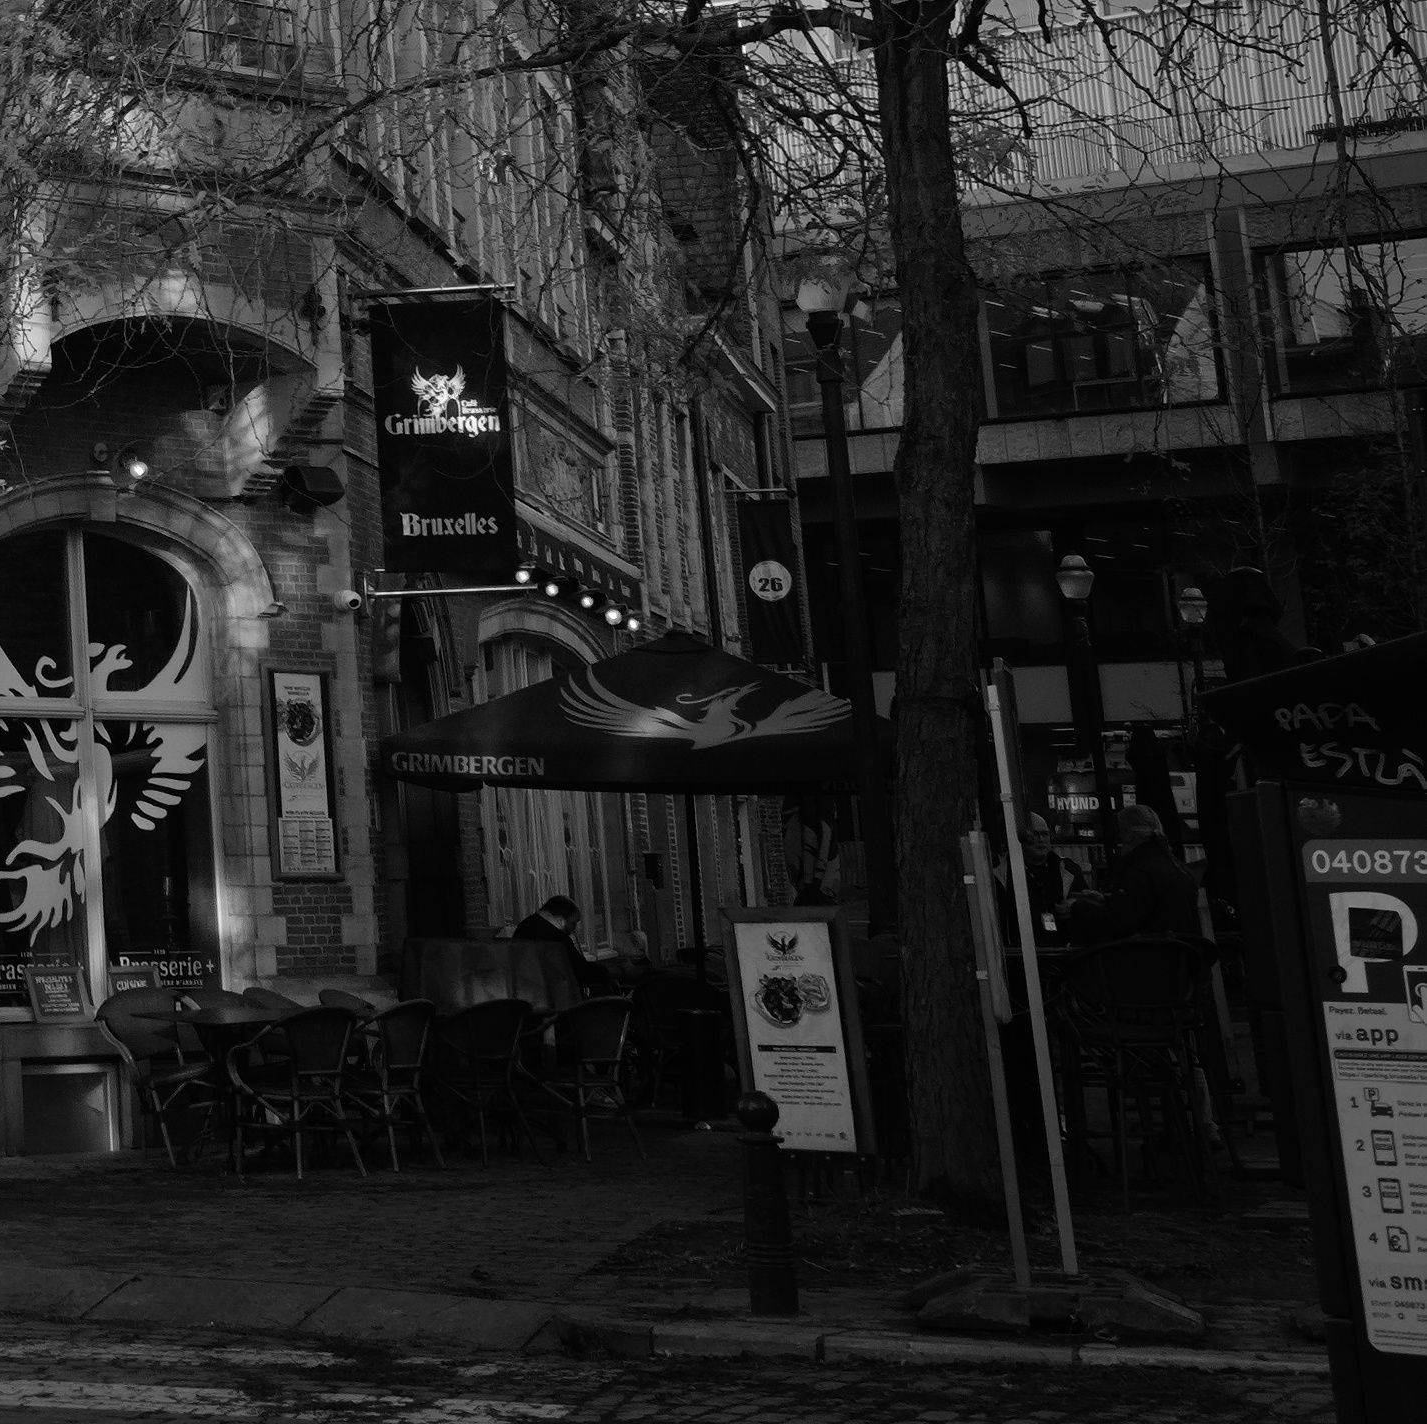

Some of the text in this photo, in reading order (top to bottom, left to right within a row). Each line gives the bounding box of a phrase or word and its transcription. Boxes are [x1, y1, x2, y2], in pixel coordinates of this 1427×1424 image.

[384, 413, 501, 438] Grimbergen
[399, 512, 499, 536] Bruxelles
[758, 577, 784, 592] 26
[1274, 702, 1382, 731] PAPA
[391, 752, 545, 776] GRIMBERGEN
[1057, 796, 1116, 811] HYUNDI
[1329, 891, 1419, 993] P
[1335, 1028, 1400, 1046] via app
[1350, 1097, 1359, 1108] 1
[1355, 1139, 1366, 1152] 2
[1361, 1185, 1373, 1198] 3
[1368, 1231, 1378, 1244] 4
[1368, 1278, 1387, 1289] via
